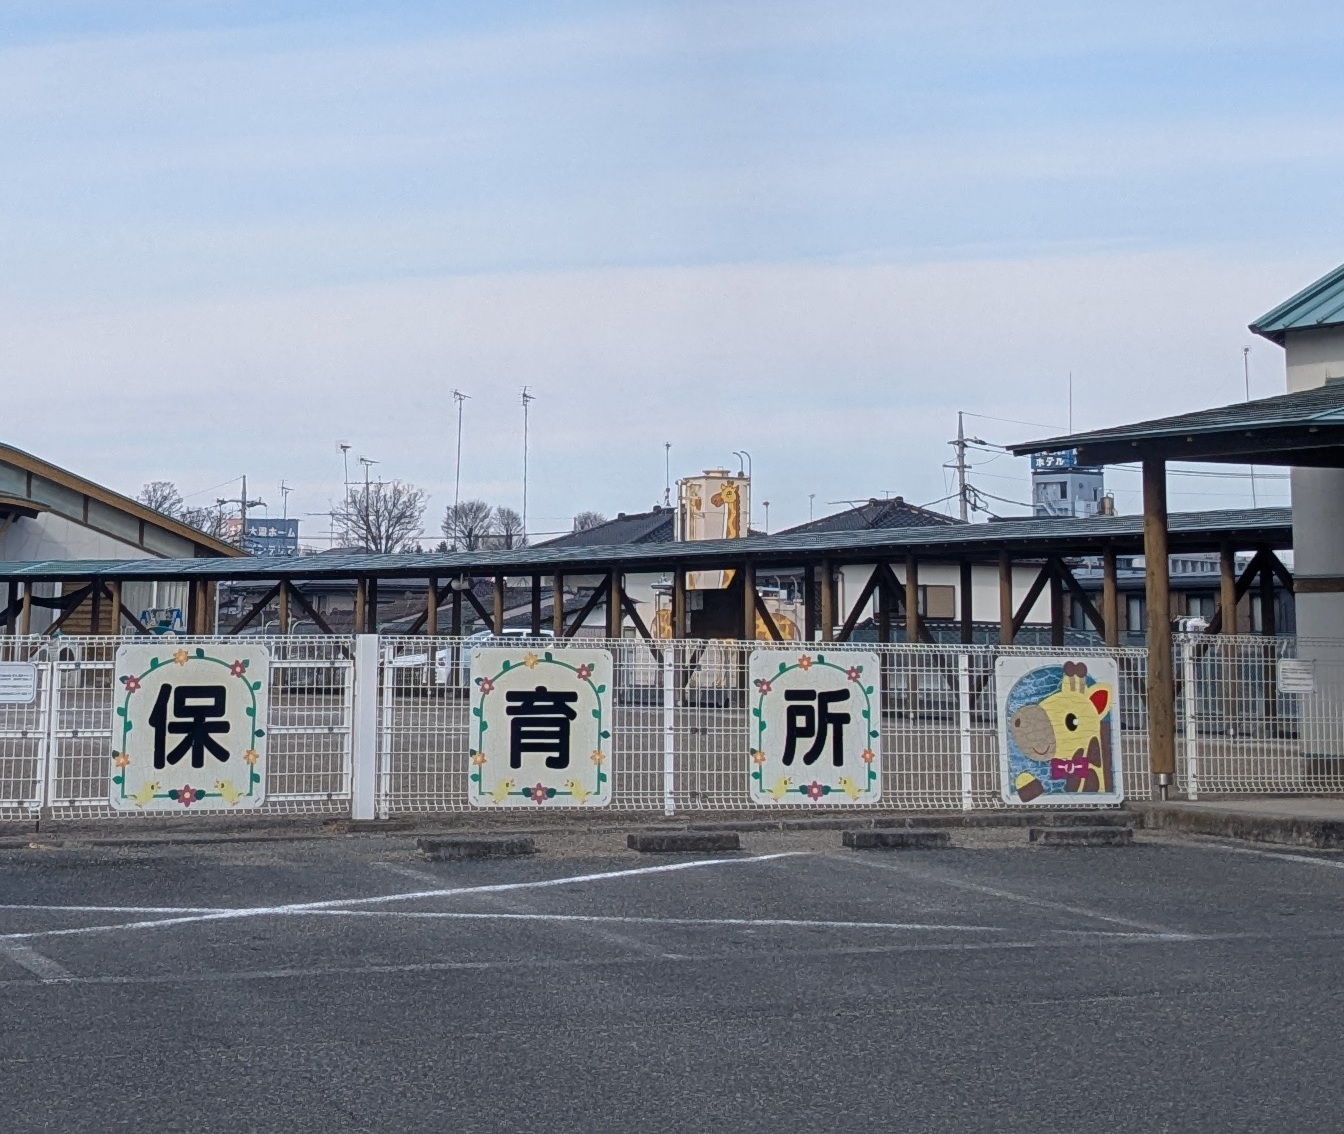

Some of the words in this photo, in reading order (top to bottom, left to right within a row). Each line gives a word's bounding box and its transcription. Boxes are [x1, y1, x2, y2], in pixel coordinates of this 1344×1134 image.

[1036, 457, 1065, 467] ホテル
[148, 683, 231, 770] 保
[505, 686, 578, 770] 育
[782, 688, 851, 768] 所
